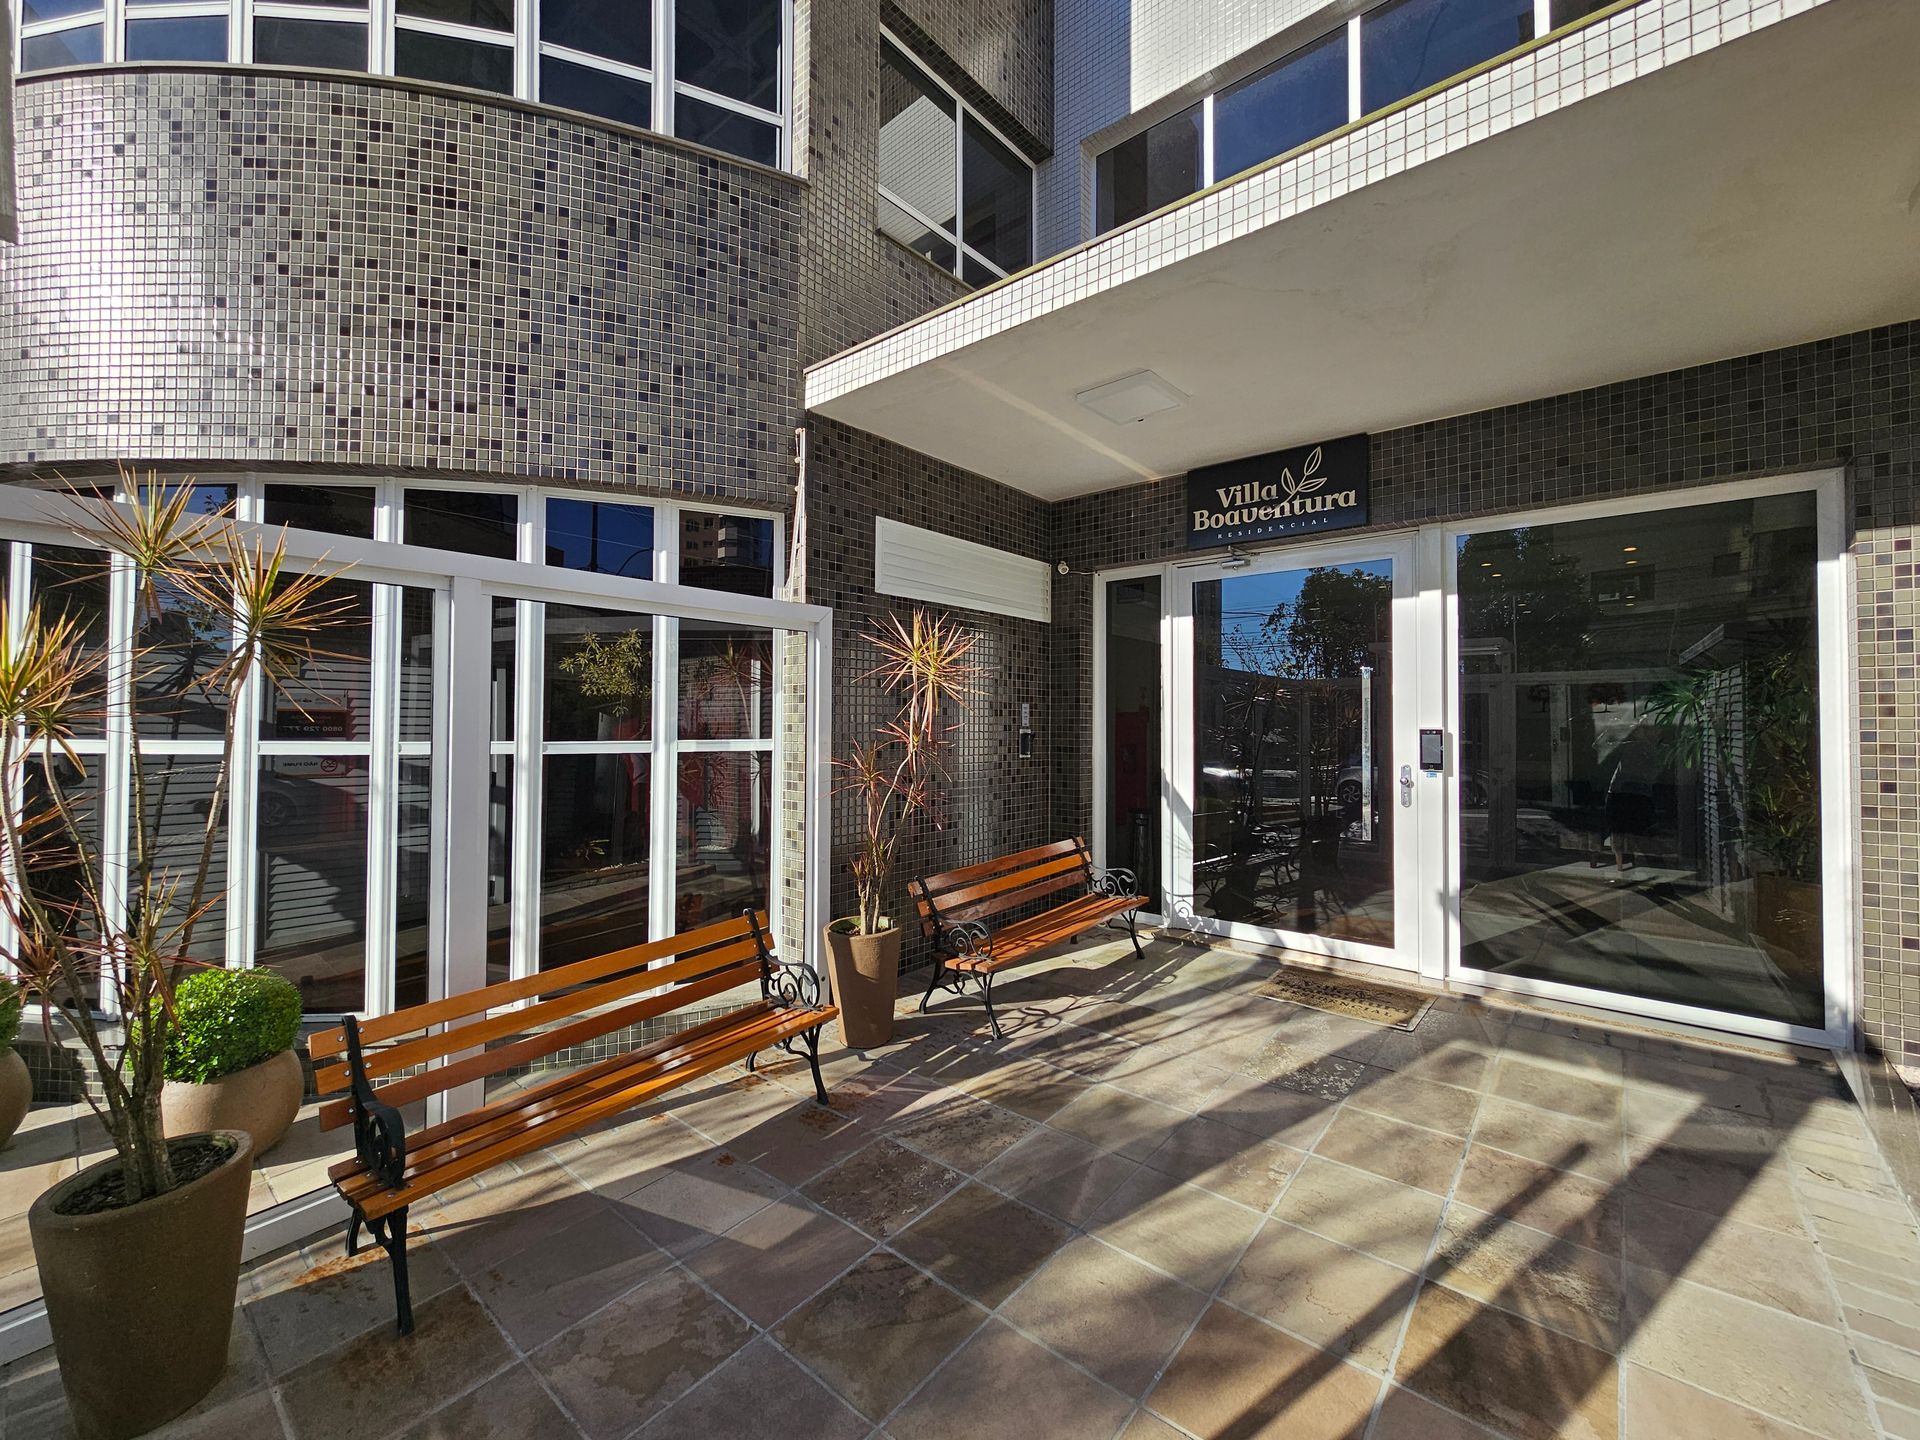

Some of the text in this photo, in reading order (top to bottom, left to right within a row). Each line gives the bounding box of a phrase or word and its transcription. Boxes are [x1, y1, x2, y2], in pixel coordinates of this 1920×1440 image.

[1216, 481, 1279, 508] Villa
[1193, 489, 1357, 531] Boaventura
[1217, 517, 1328, 539] RESIDENCIAL
